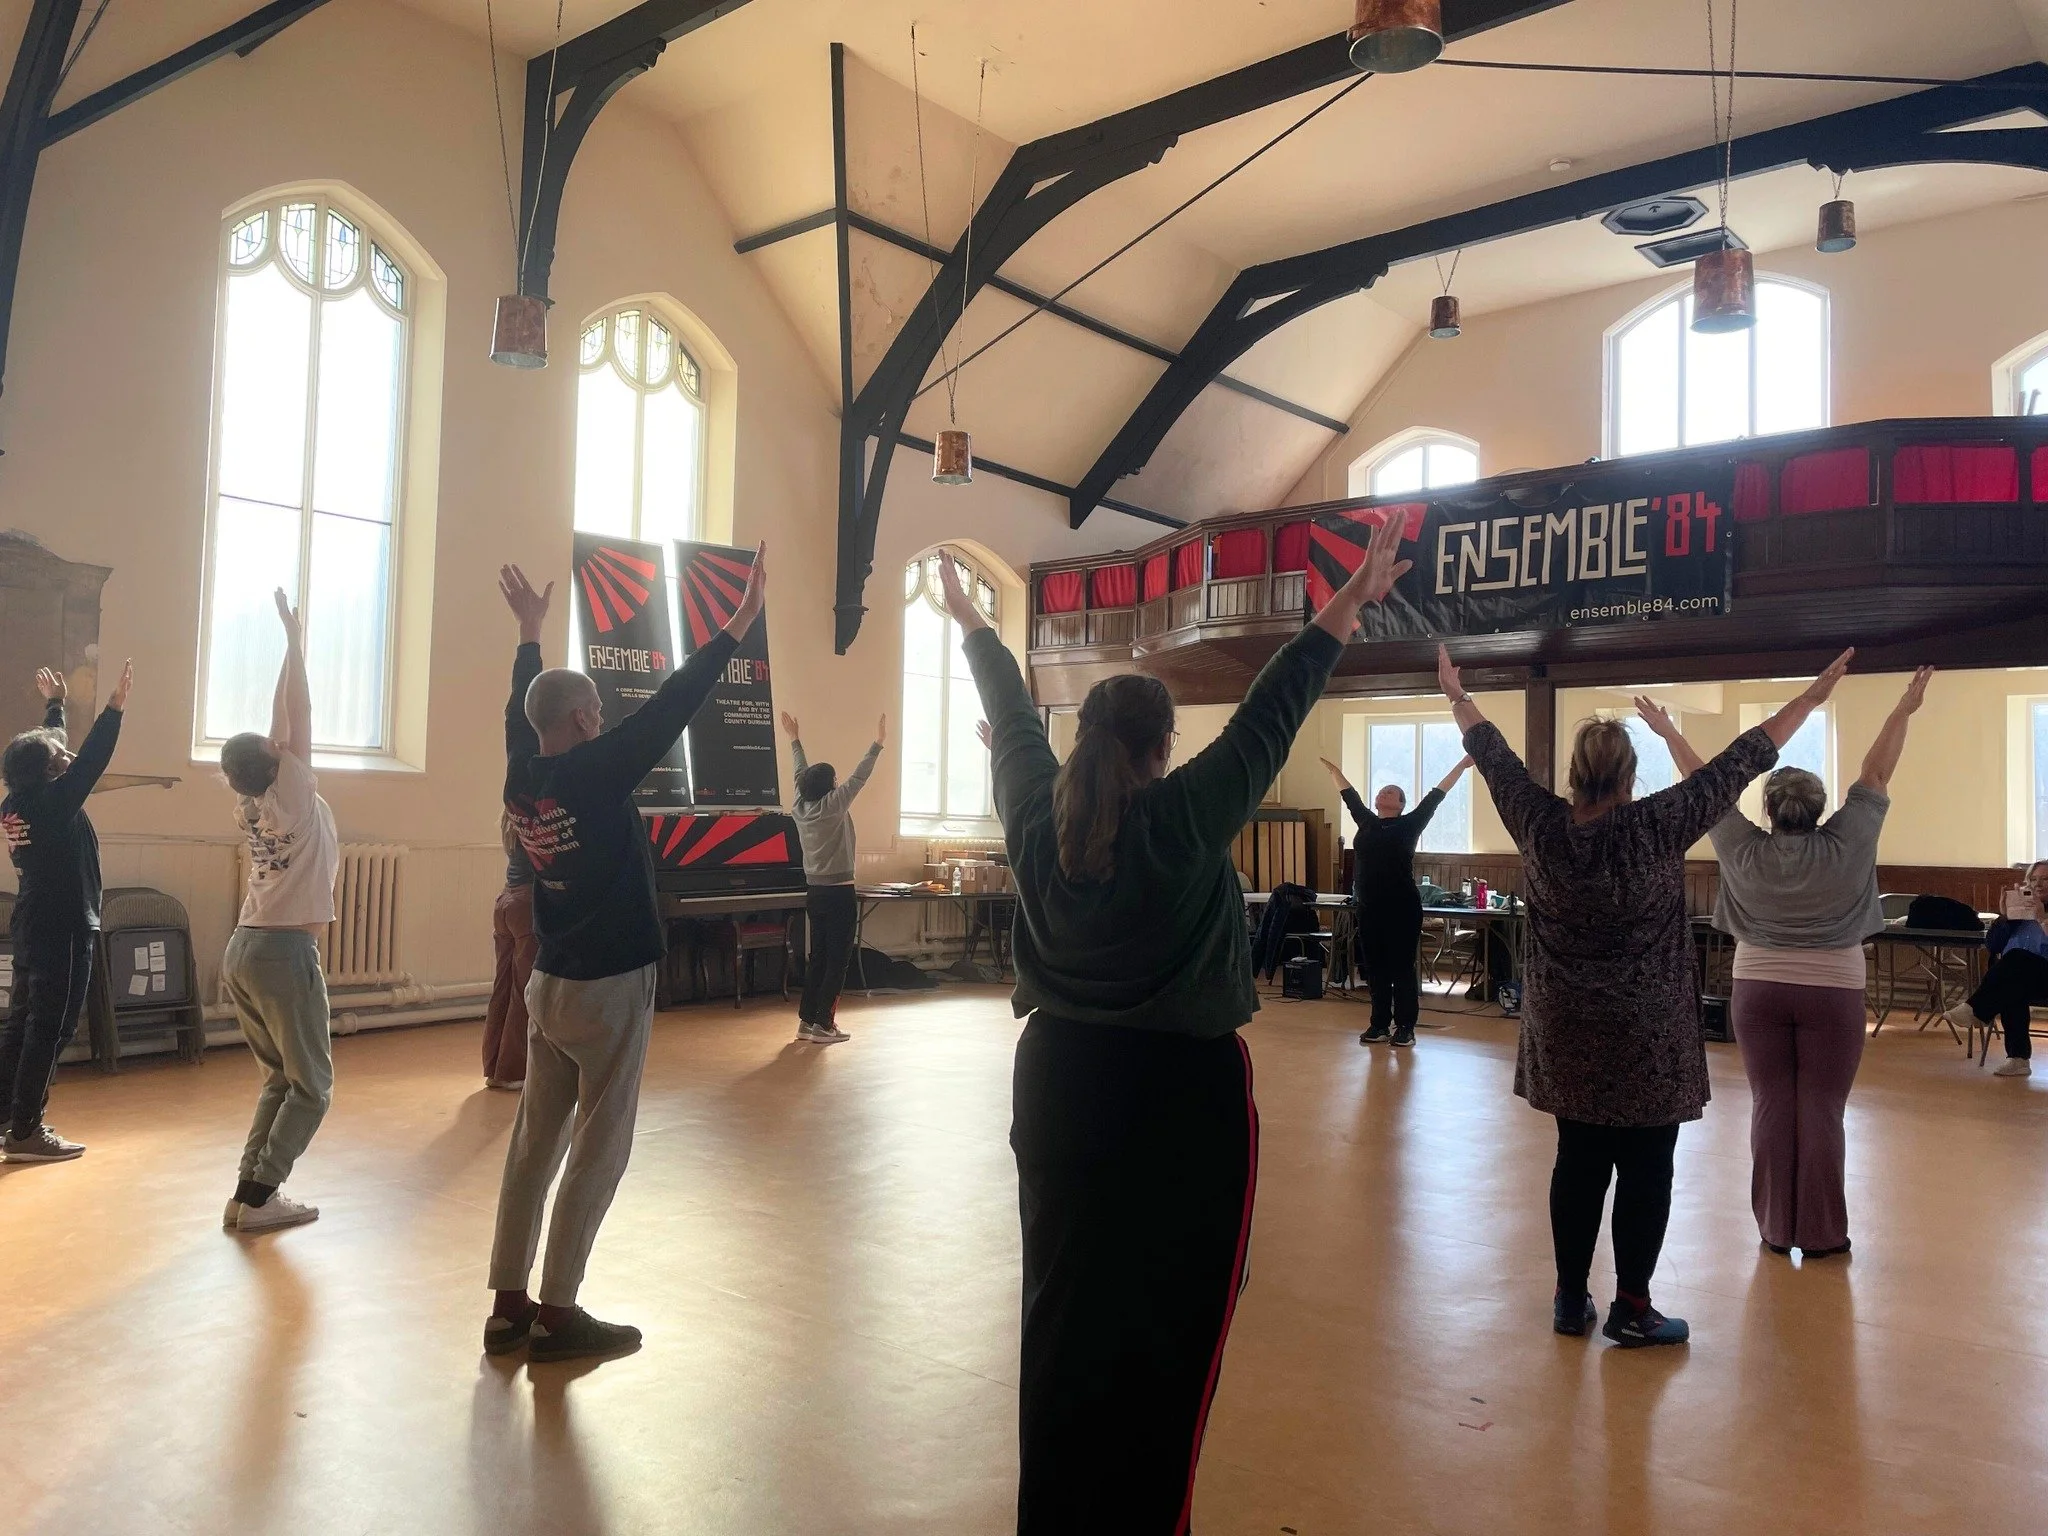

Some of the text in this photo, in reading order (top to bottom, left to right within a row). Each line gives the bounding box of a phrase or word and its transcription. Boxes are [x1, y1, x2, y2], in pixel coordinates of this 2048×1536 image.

[1570, 594, 1719, 620] ensemble84.com
[716, 698, 740, 706] THEATRE
[540, 807, 567, 821] with
[535, 817, 577, 835] diverse
[561, 827, 574, 839] of
